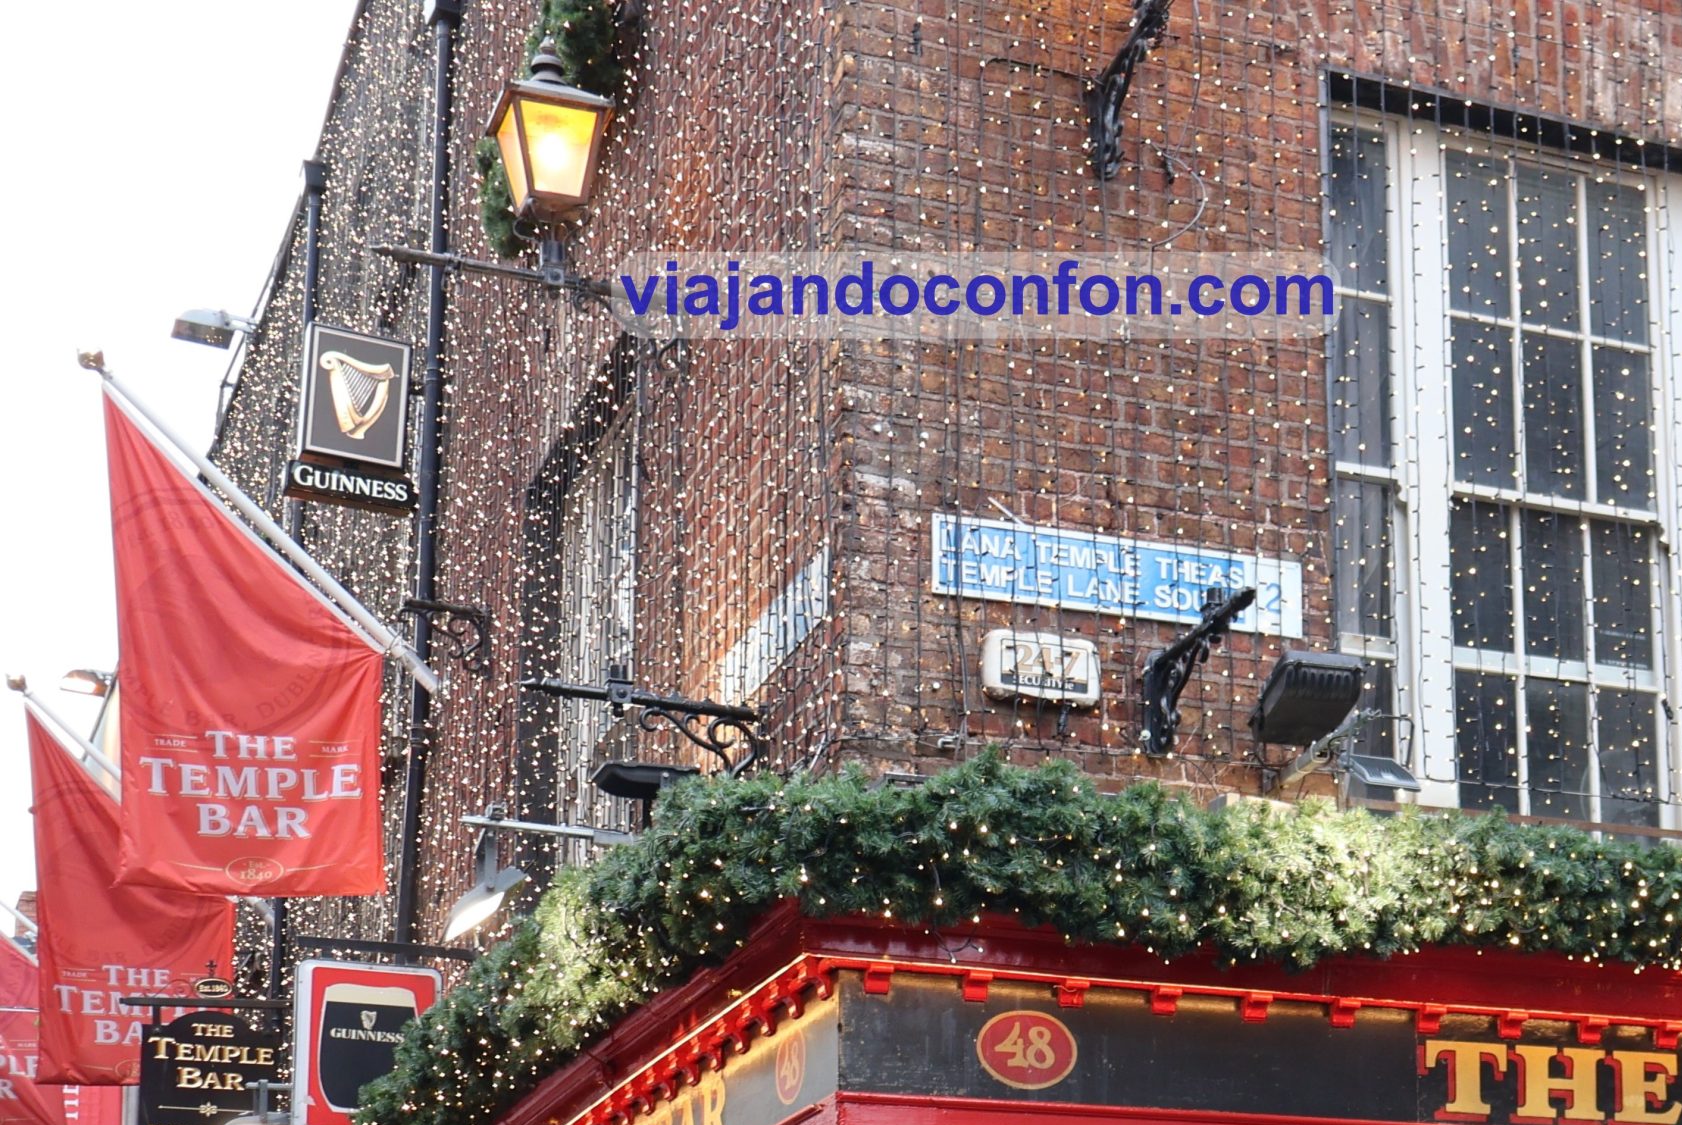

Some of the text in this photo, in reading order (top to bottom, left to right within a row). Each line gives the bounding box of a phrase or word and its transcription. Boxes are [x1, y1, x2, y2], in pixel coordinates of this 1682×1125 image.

[294, 465, 408, 501] GUINNESS
[941, 525, 1244, 589] LANA TEMPLE THEAS
[941, 558, 1208, 613] TEMPLE LANE SOU
[1265, 582, 1282, 613] 2
[205, 730, 297, 761] THE
[139, 756, 363, 801] TEMPLE
[196, 803, 313, 839] BAR
[239, 869, 274, 881] 1840
[102, 964, 171, 990] THE
[93, 1019, 143, 1046] BA
[192, 1023, 235, 1038] THE
[330, 1027, 405, 1044] GUINNESS
[994, 1021, 1055, 1071] 48
[148, 1037, 275, 1066] TEMPLE
[781, 1040, 800, 1092] 48
[177, 1066, 246, 1091] BAR
[1421, 1040, 1682, 1124] THE
